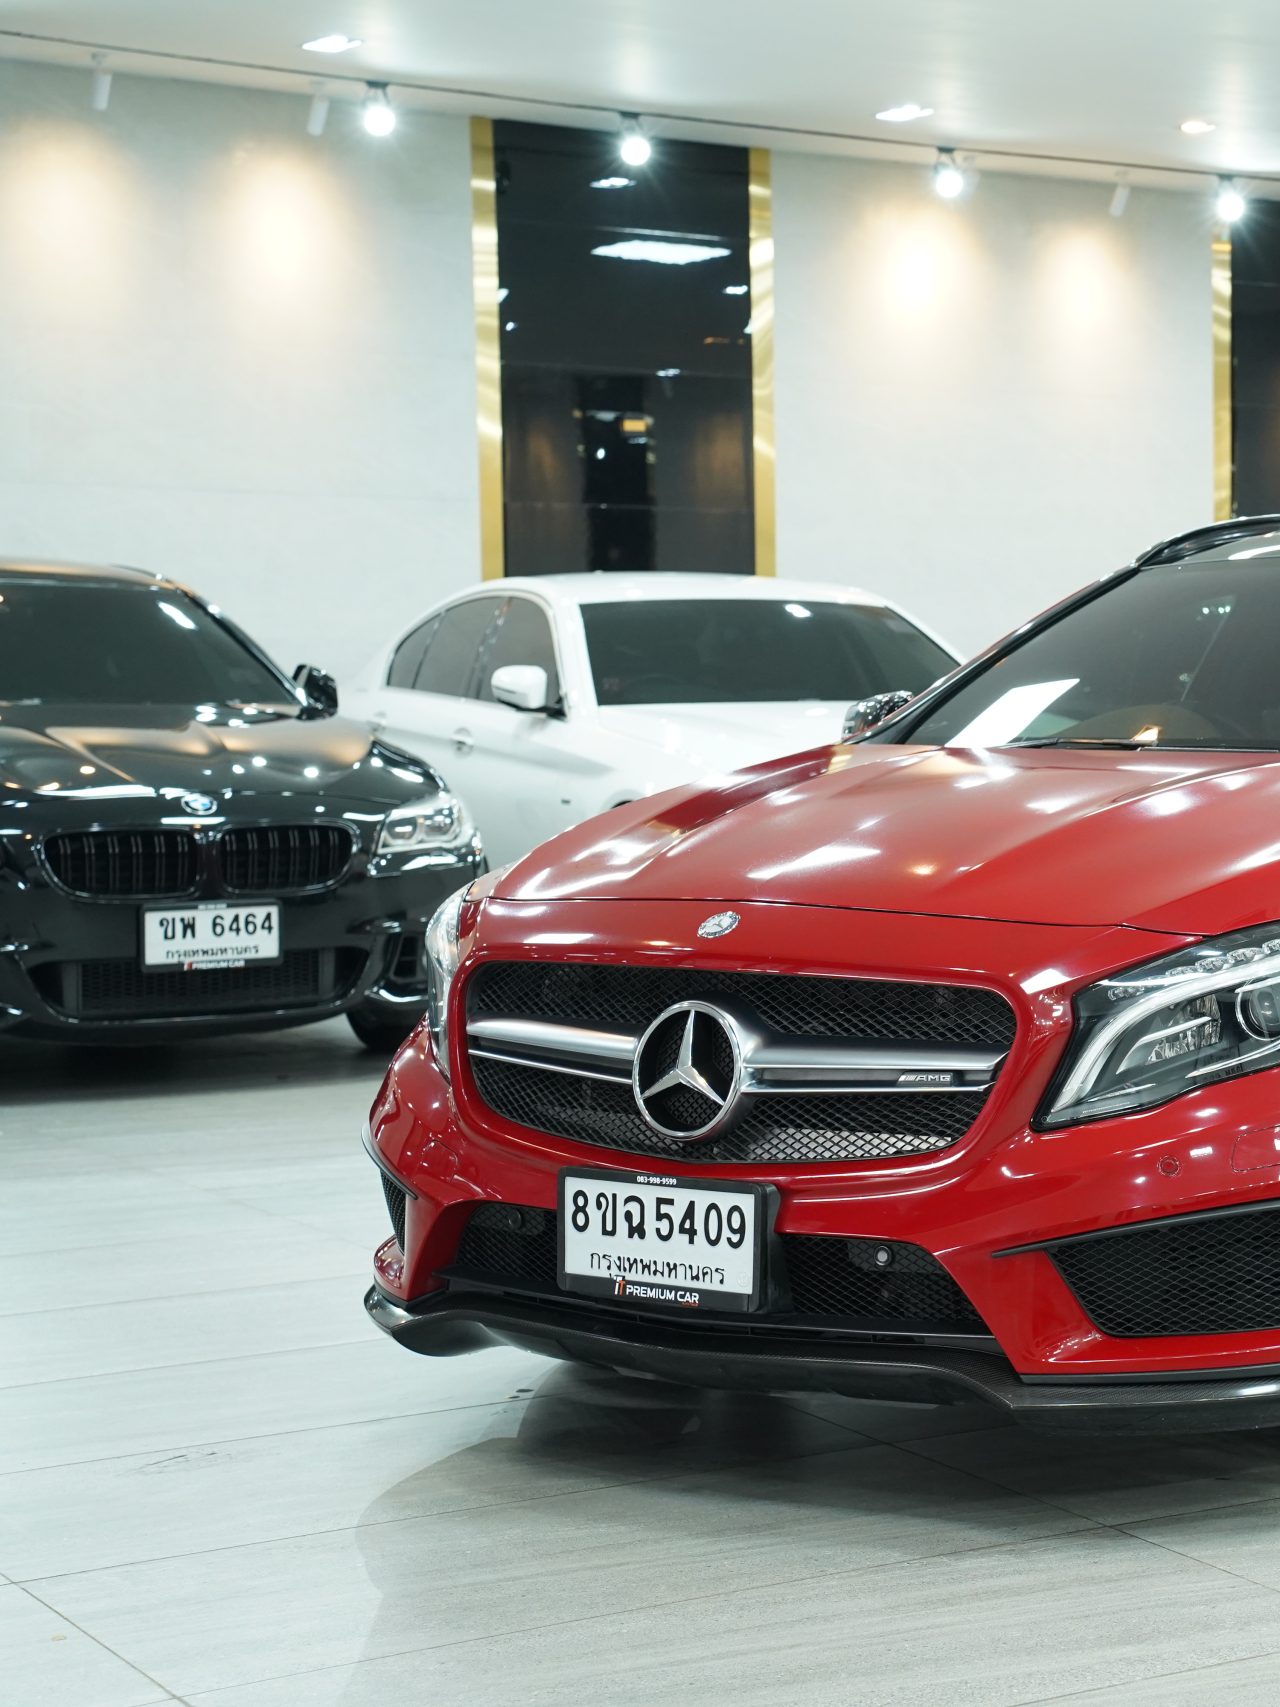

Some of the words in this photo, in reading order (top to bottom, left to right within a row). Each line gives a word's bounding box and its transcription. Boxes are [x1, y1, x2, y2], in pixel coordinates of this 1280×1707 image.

[159, 916, 197, 941] ขพ
[212, 912, 273, 937] 6464
[915, 1074, 952, 1082] AMG
[571, 1189, 647, 1240] 8ขฉ
[655, 1197, 747, 1250] 5409
[590, 1252, 725, 1285] กรุงเทพมหานคร
[625, 1284, 676, 1301] PREMIUM
[676, 1290, 700, 1304] CAR
